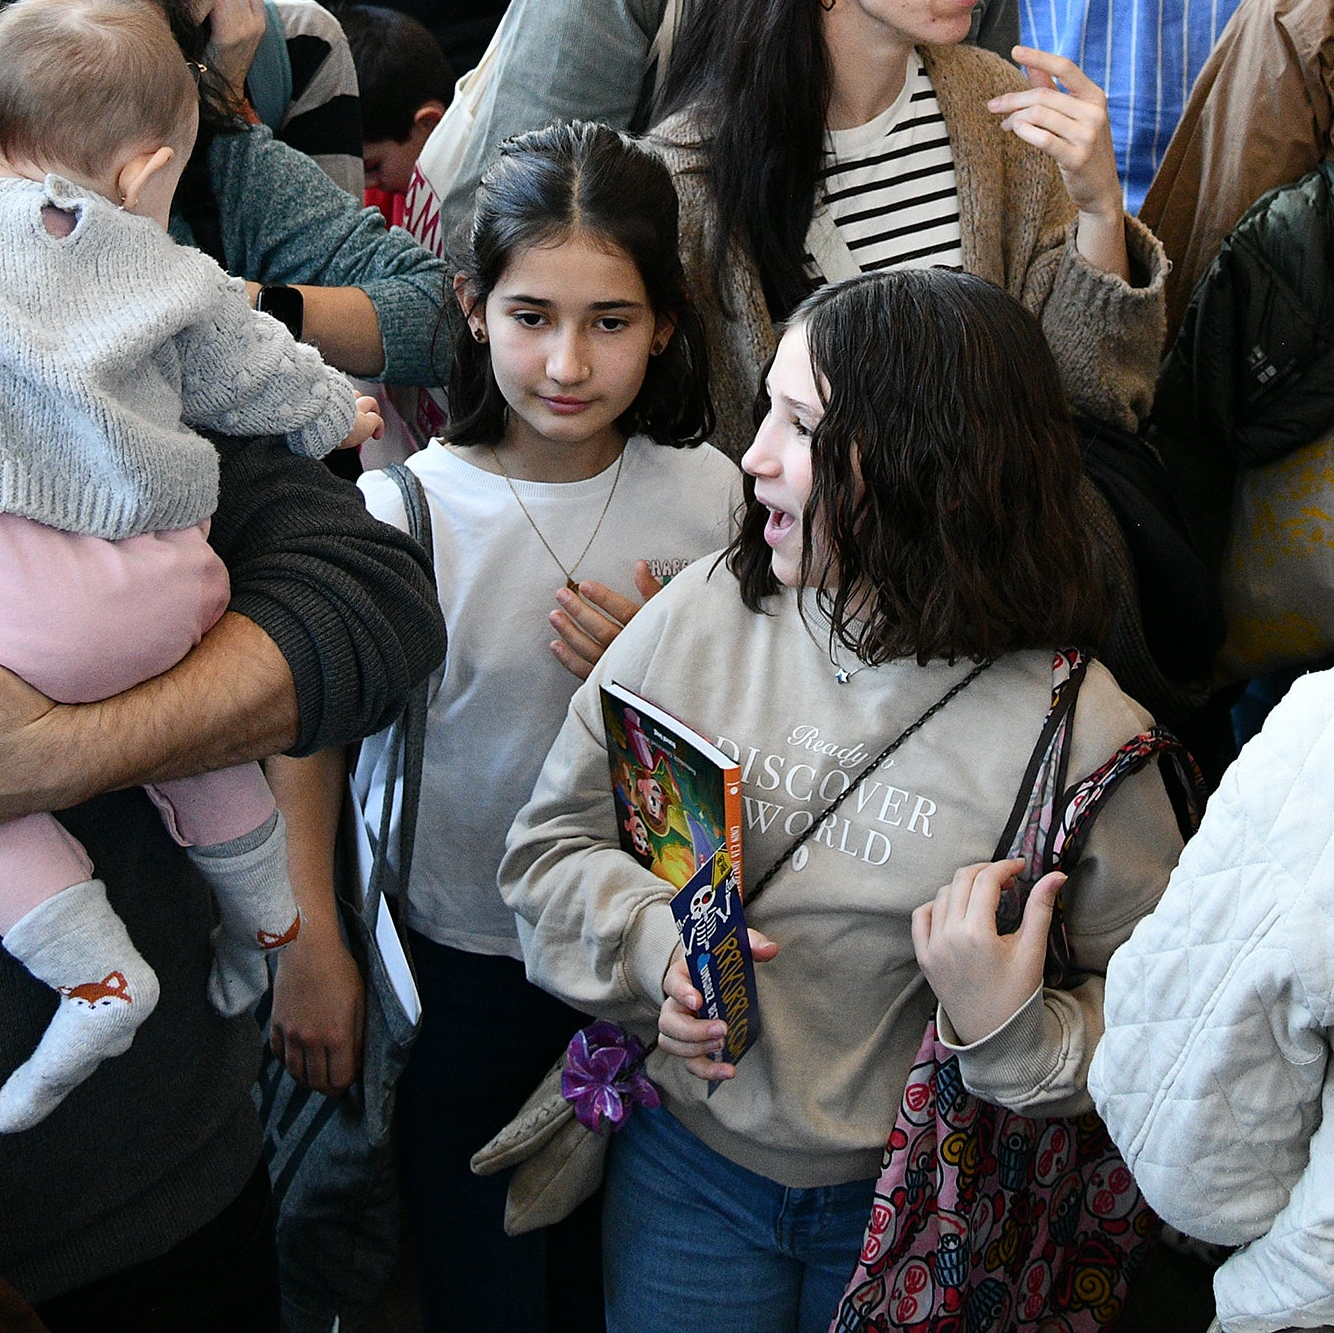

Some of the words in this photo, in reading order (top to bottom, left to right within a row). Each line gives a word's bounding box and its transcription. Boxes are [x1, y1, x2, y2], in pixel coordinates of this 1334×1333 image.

[787, 724, 870, 769] Ready
[715, 735, 938, 839] DISCOVER
[742, 794, 893, 867] WORLD
